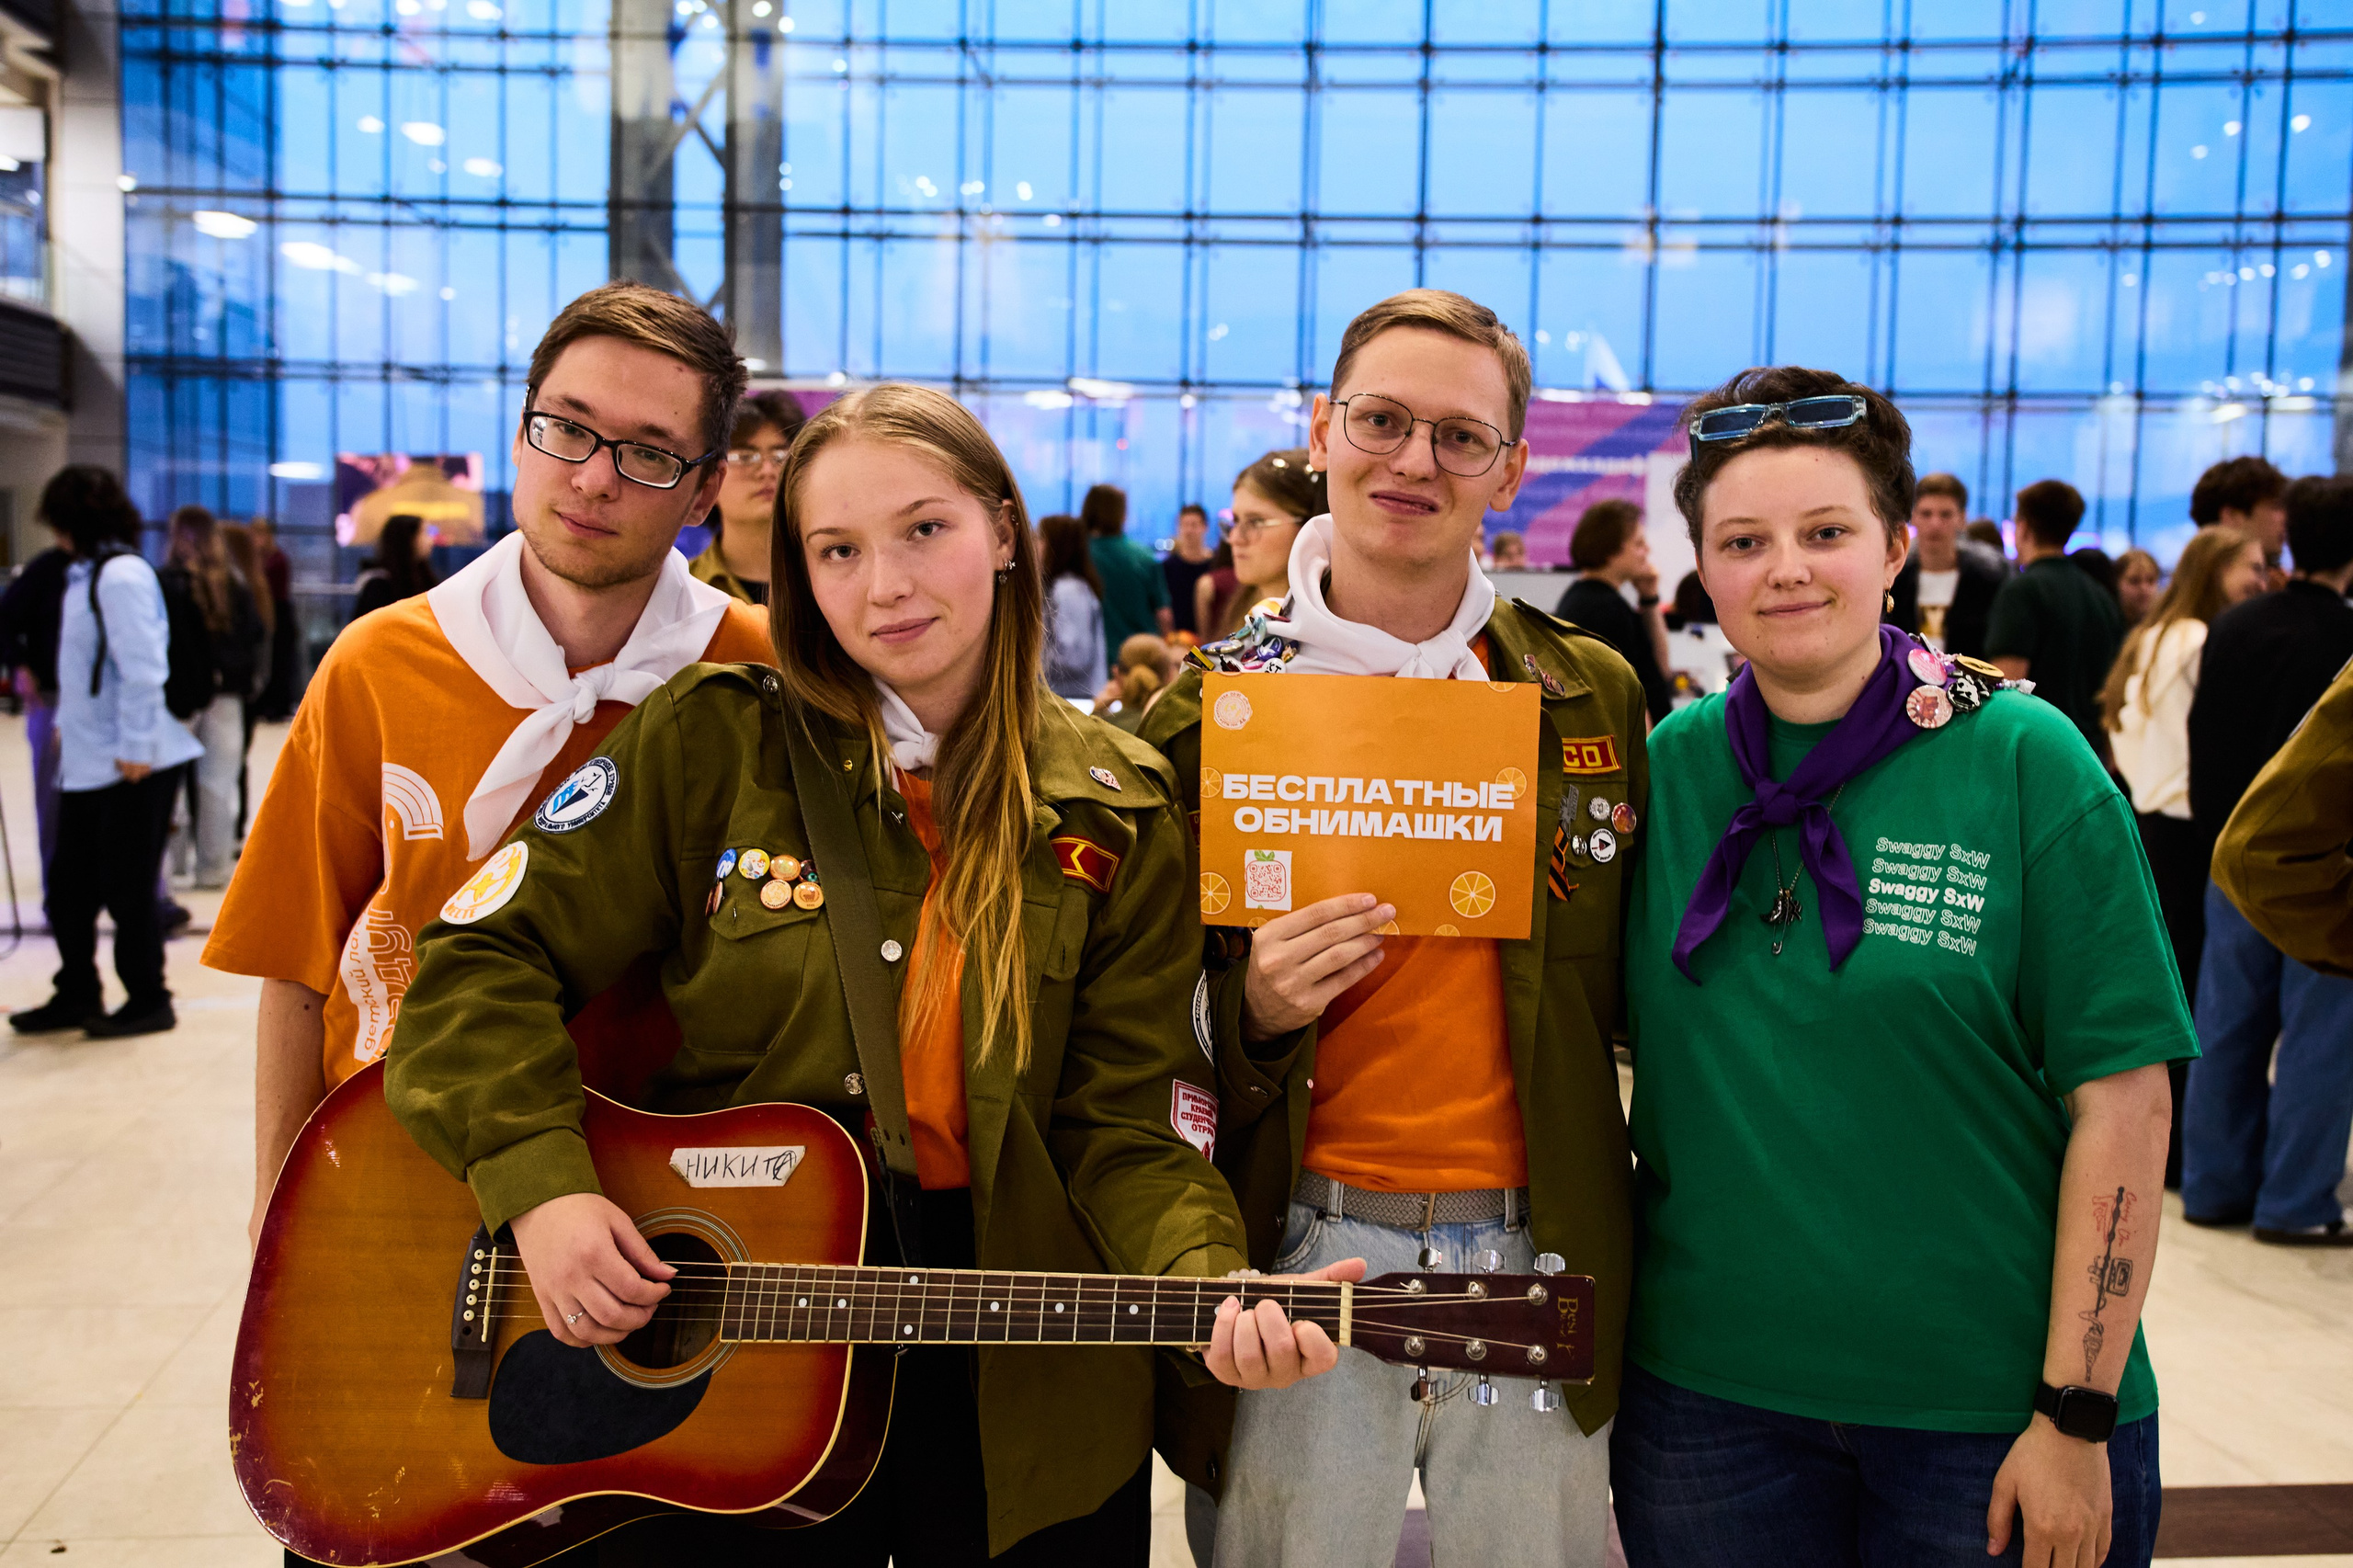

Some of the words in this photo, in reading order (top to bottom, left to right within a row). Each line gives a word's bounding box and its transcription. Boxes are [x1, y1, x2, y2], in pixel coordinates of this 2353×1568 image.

[1222, 773, 1515, 810] БЕСПЛАТНЫЕ
[1233, 806, 1503, 842] ОБНИМАШКИ
[1876, 837, 1946, 860] Swaggy
[1949, 844, 1991, 869] SxW
[1872, 858, 1942, 882] Swaggy
[1946, 866, 1987, 891] SxW
[1869, 878, 1939, 903] Swaggy
[1943, 888, 1984, 913] SxW
[1865, 898, 1937, 925] Swaggy
[1940, 909, 1981, 934] SxW
[1862, 918, 1933, 945] Swaggy
[1938, 930, 1977, 957] SxW
[686, 1150, 797, 1180] НИКИТА
